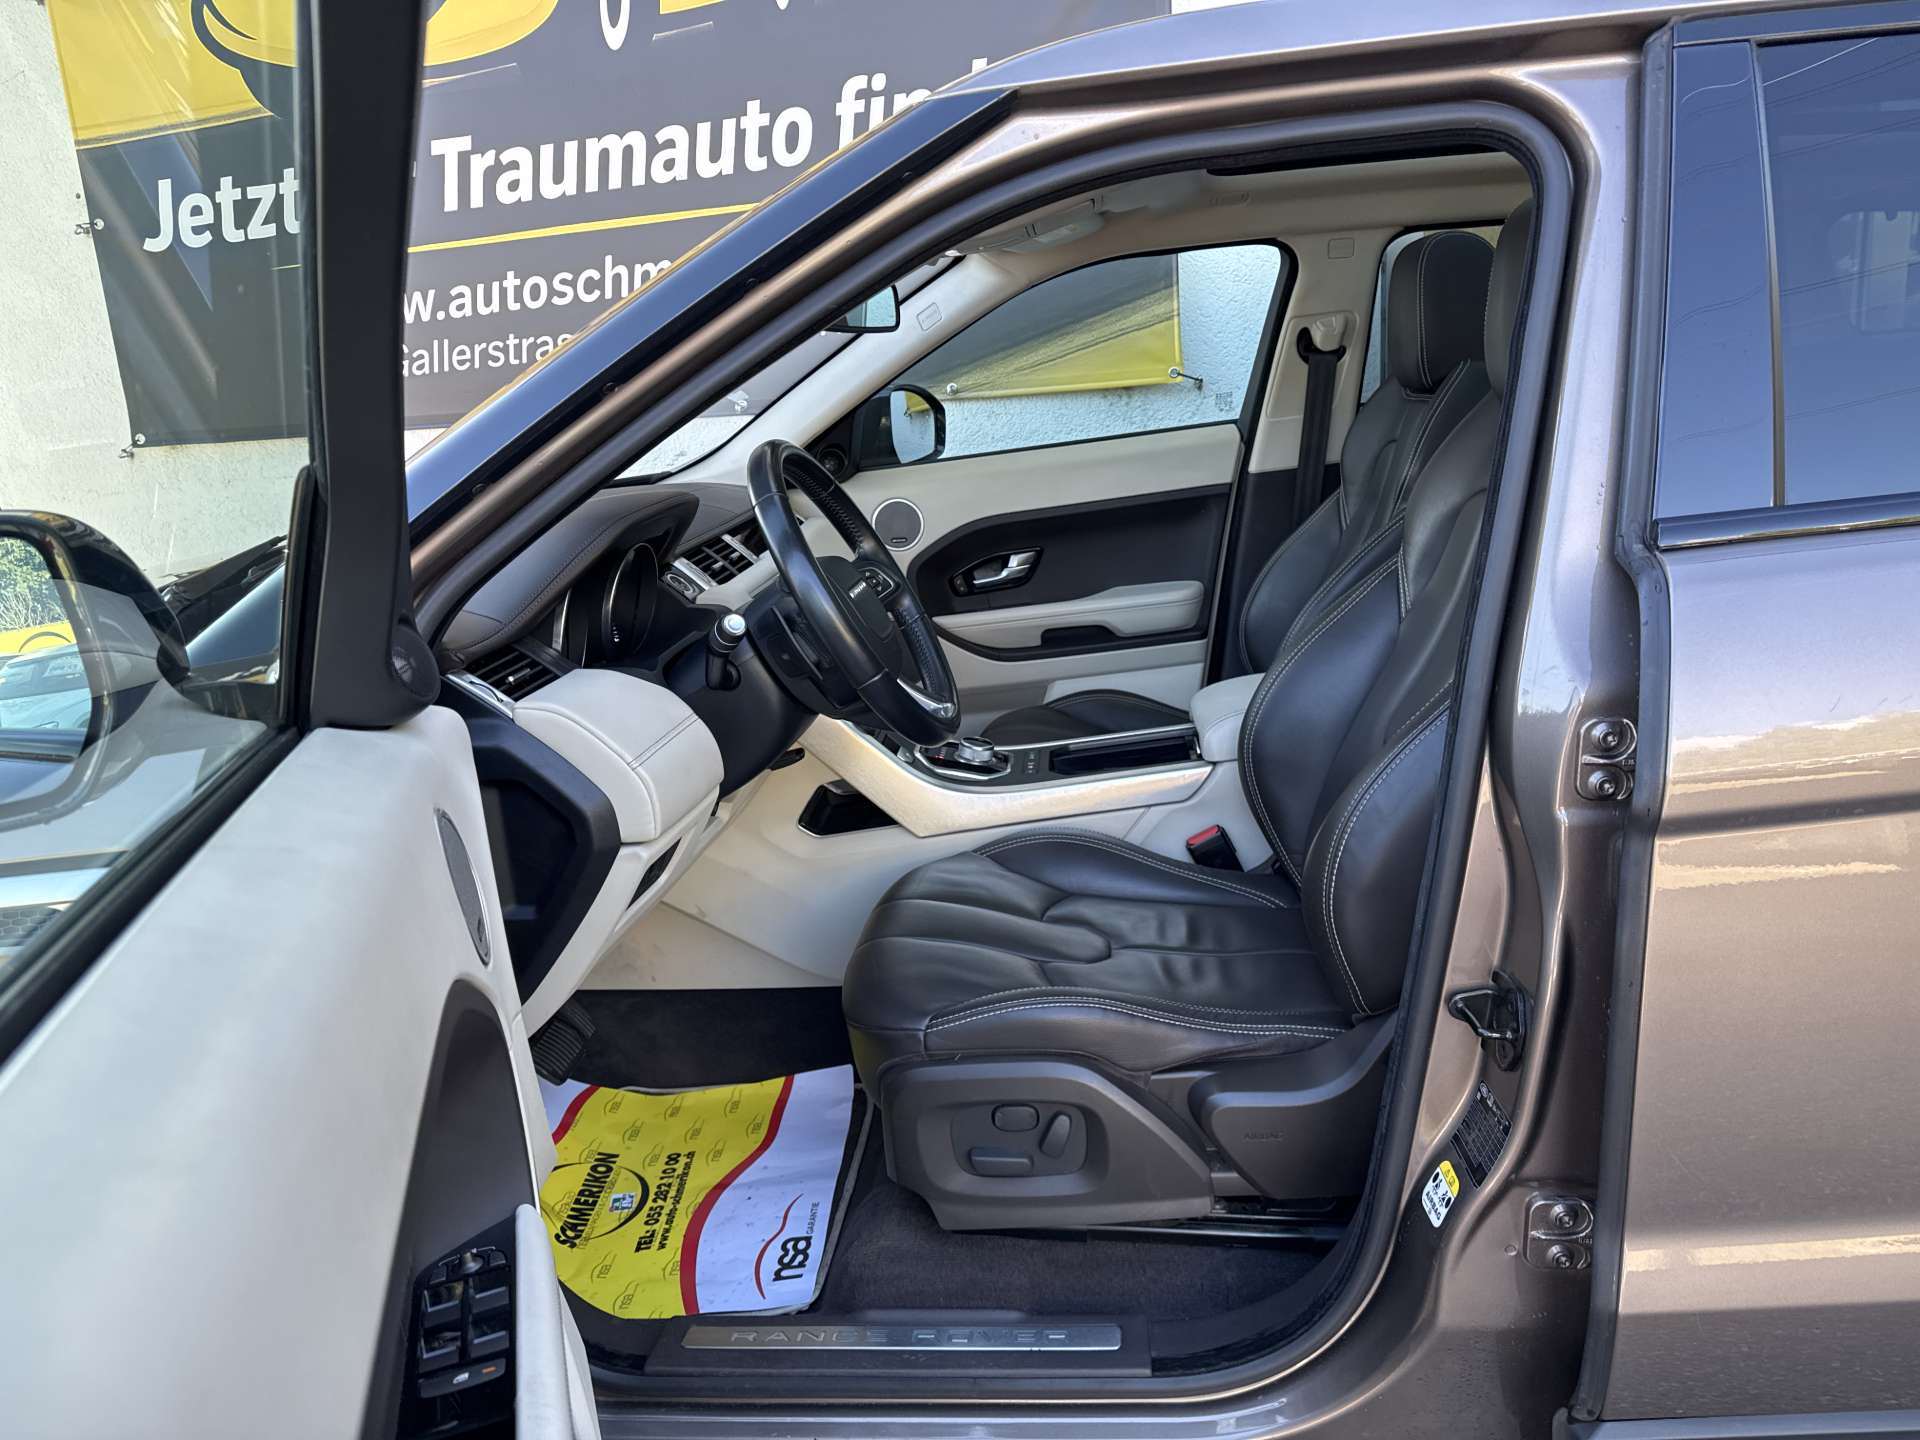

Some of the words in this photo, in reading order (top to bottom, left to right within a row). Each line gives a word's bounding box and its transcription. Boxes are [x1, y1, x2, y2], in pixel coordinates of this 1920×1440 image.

[142, 166, 301, 252] Jetzt
[431, 106, 813, 212] Traumauto
[665, 1152, 682, 1166] 00
[660, 1167, 676, 1182] 10
[652, 1181, 673, 1203] 282
[657, 1151, 696, 1251] www.auto-schmerikon.ch
[644, 1202, 665, 1226] 055
[806, 1201, 820, 1235] GARANTIE
[634, 1228, 657, 1253] TEL:
[772, 1235, 813, 1281] nsa
[730, 1329, 889, 1343] RANGE
